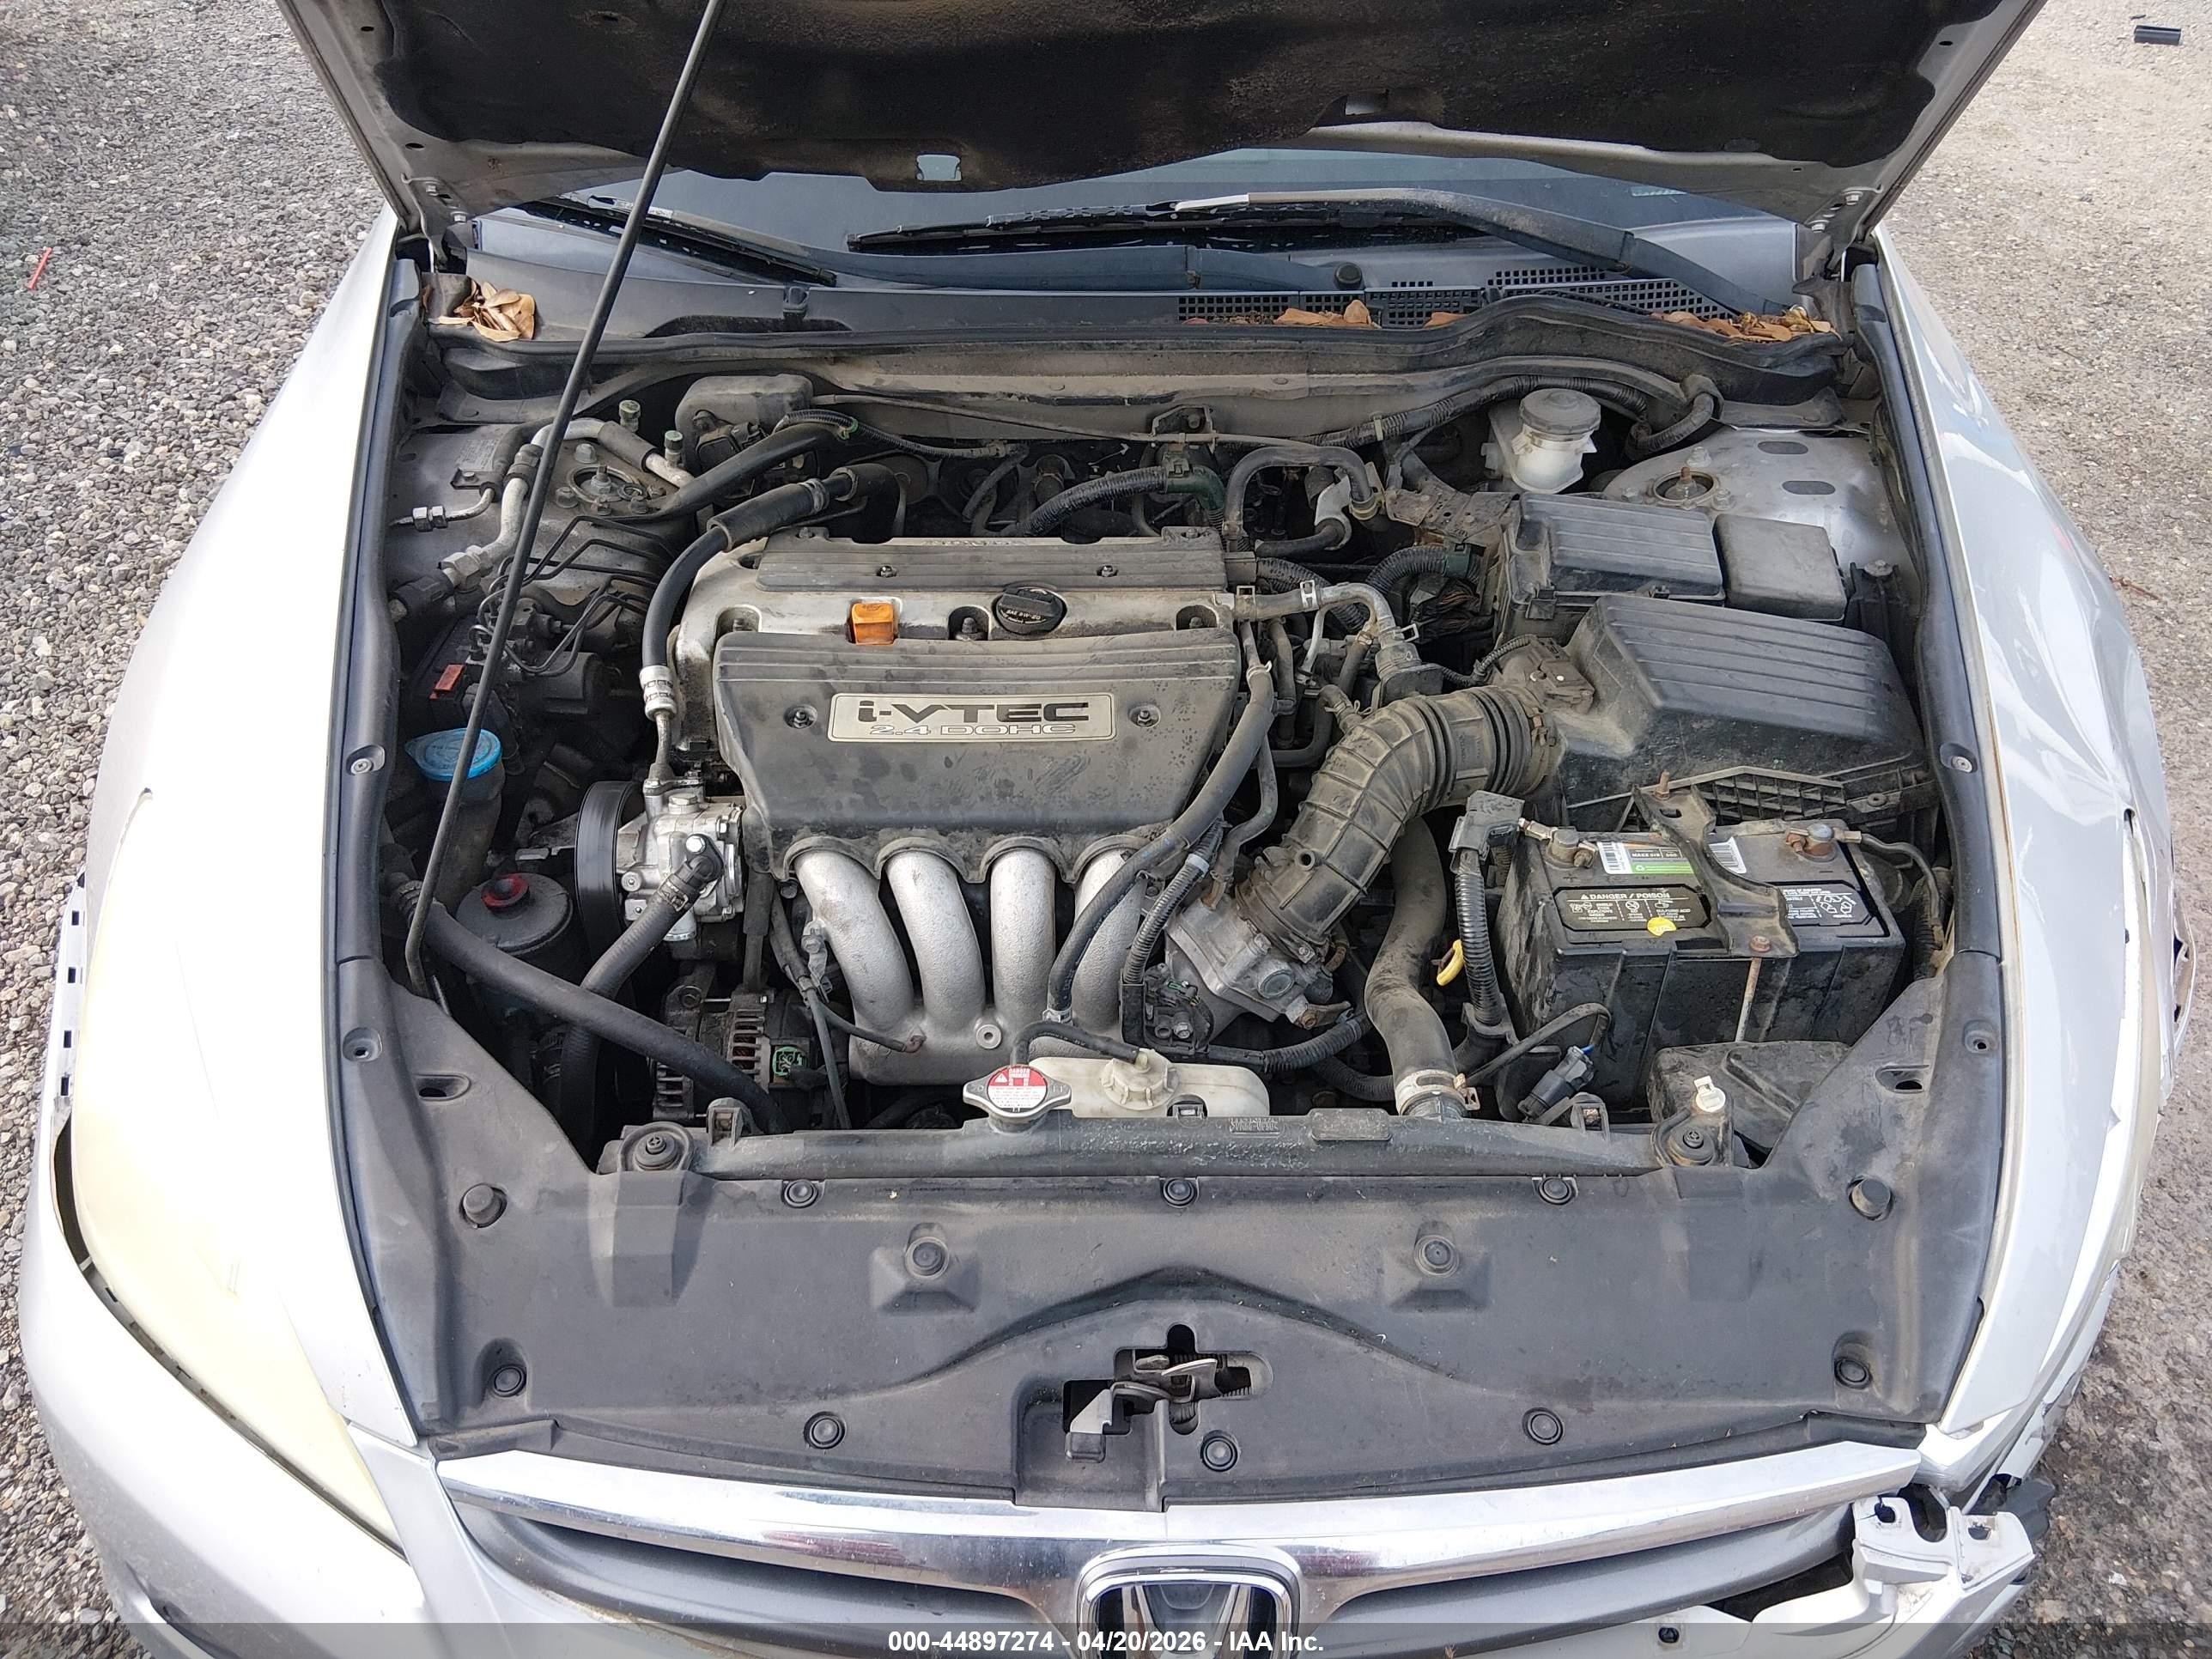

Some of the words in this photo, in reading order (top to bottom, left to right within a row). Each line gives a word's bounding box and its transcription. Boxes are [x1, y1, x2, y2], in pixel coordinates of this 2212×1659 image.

[858, 700, 1089, 723] i-VTEC
[870, 725, 931, 736] 2.4
[940, 724, 1076, 735] DOHC
